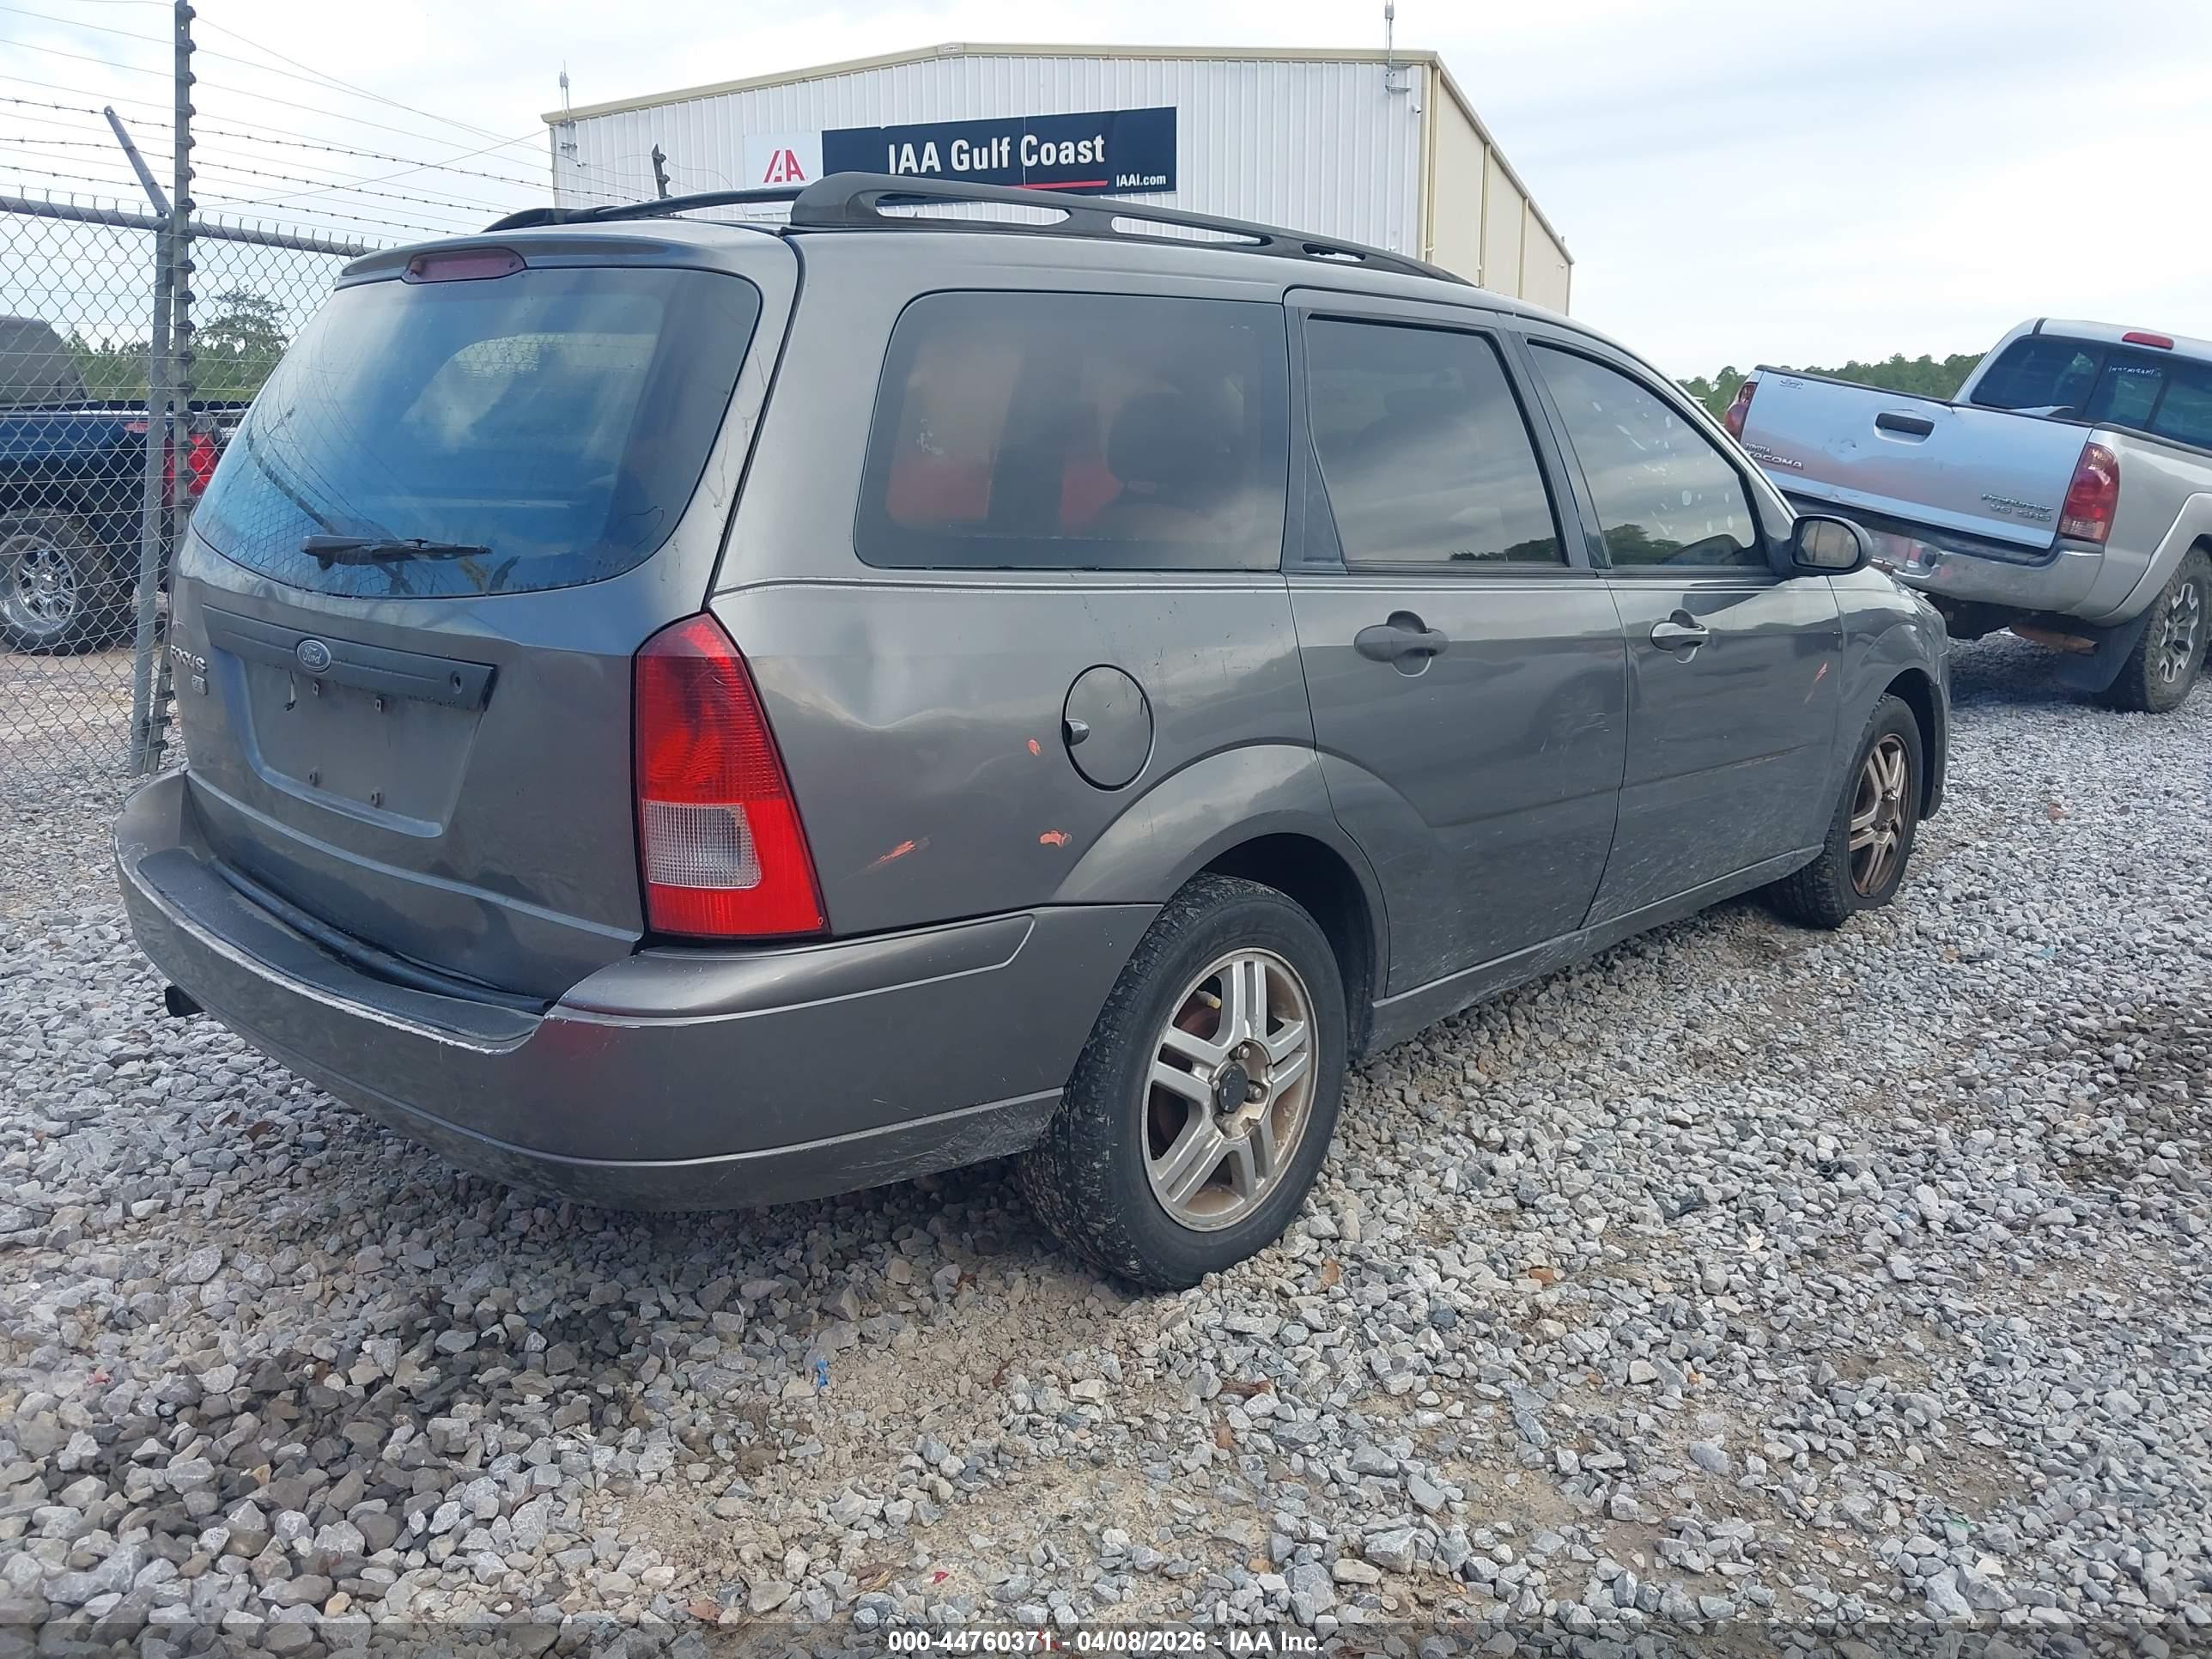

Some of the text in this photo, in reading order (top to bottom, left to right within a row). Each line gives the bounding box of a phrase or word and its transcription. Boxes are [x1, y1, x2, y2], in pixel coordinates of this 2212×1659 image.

[888, 134, 1105, 175] IAA Gulf Coast
[1115, 173, 1167, 188] IAAI.com
[1745, 450, 1803, 470] TACOMA
[302, 645, 322, 665] Ford
